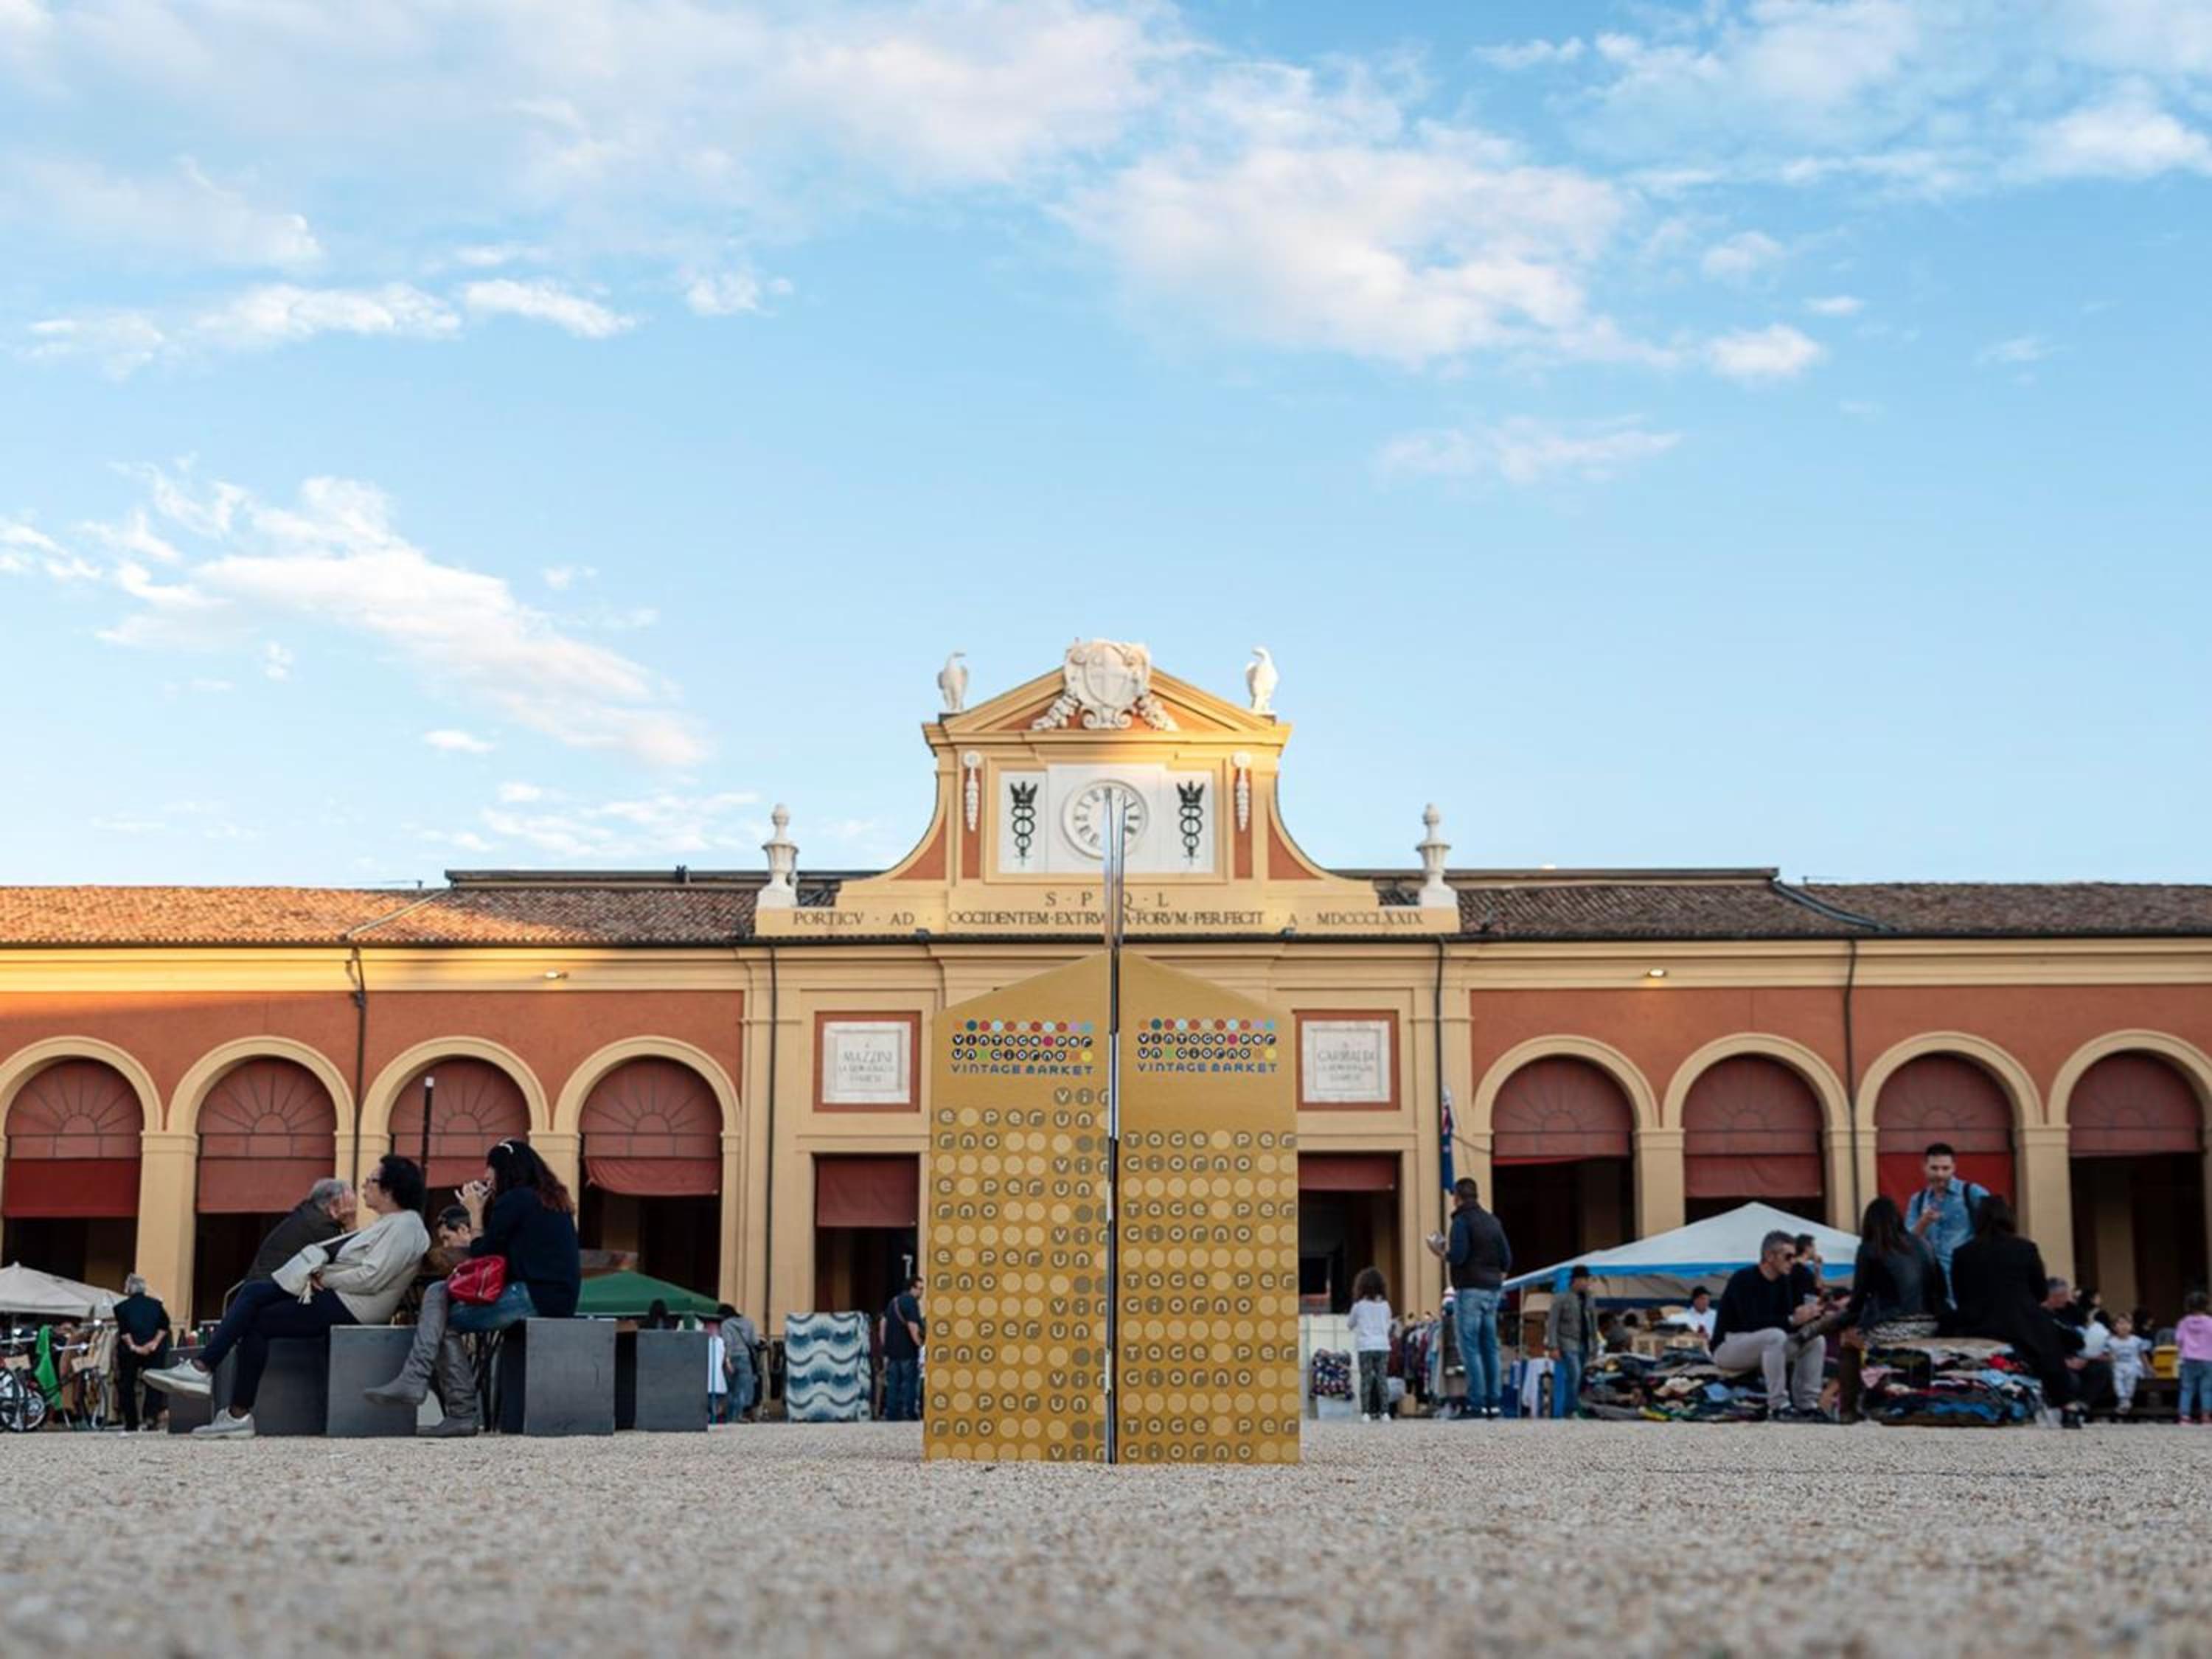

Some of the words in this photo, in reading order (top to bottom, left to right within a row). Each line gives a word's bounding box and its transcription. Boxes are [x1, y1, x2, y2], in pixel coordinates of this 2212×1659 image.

[1045, 891, 1057, 906] S
[1081, 891, 1093, 906] P
[1157, 891, 1169, 907] L
[793, 911, 864, 925] PORTICV
[889, 912, 914, 925] AD
[951, 1064, 1020, 1074] VINTAGE
[1138, 1063, 1206, 1074] VINTAGE
